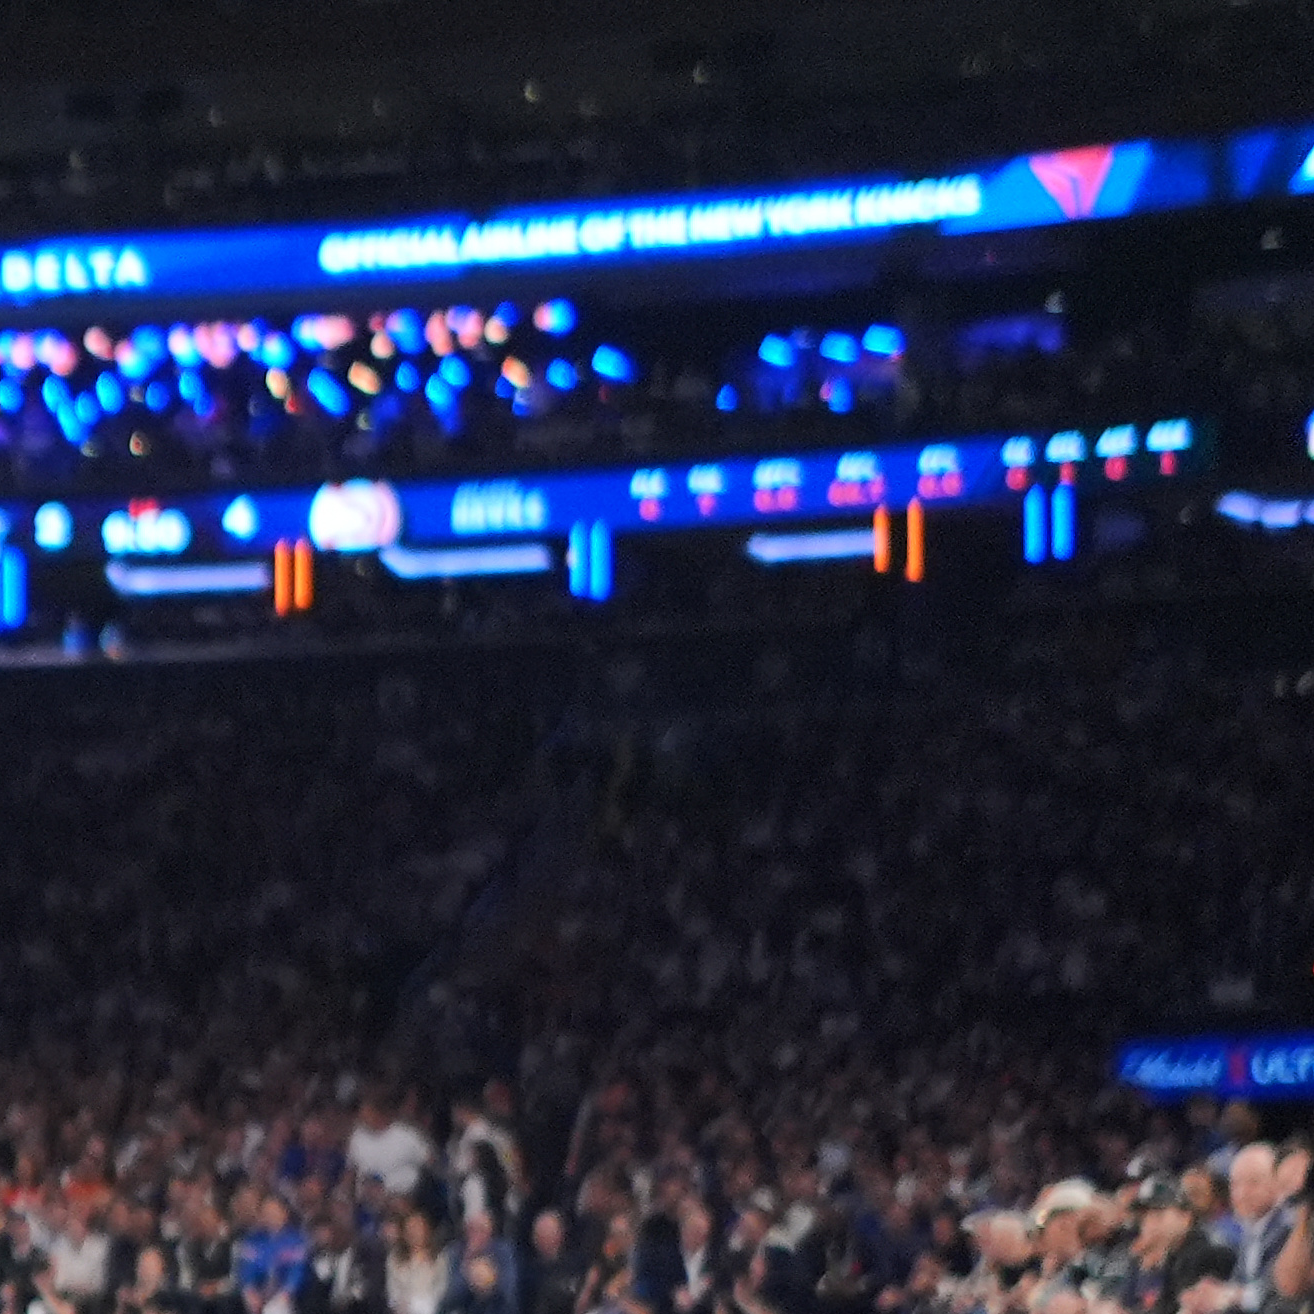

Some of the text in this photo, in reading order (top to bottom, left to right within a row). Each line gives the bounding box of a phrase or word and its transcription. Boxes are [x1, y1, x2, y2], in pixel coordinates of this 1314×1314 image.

[579, 212, 625, 252] OF
[628, 208, 687, 250] THE
[689, 201, 763, 242] NEW
[764, 192, 854, 237] YORK
[855, 174, 981, 227] KNICKS
[0, 246, 148, 293] DELTA
